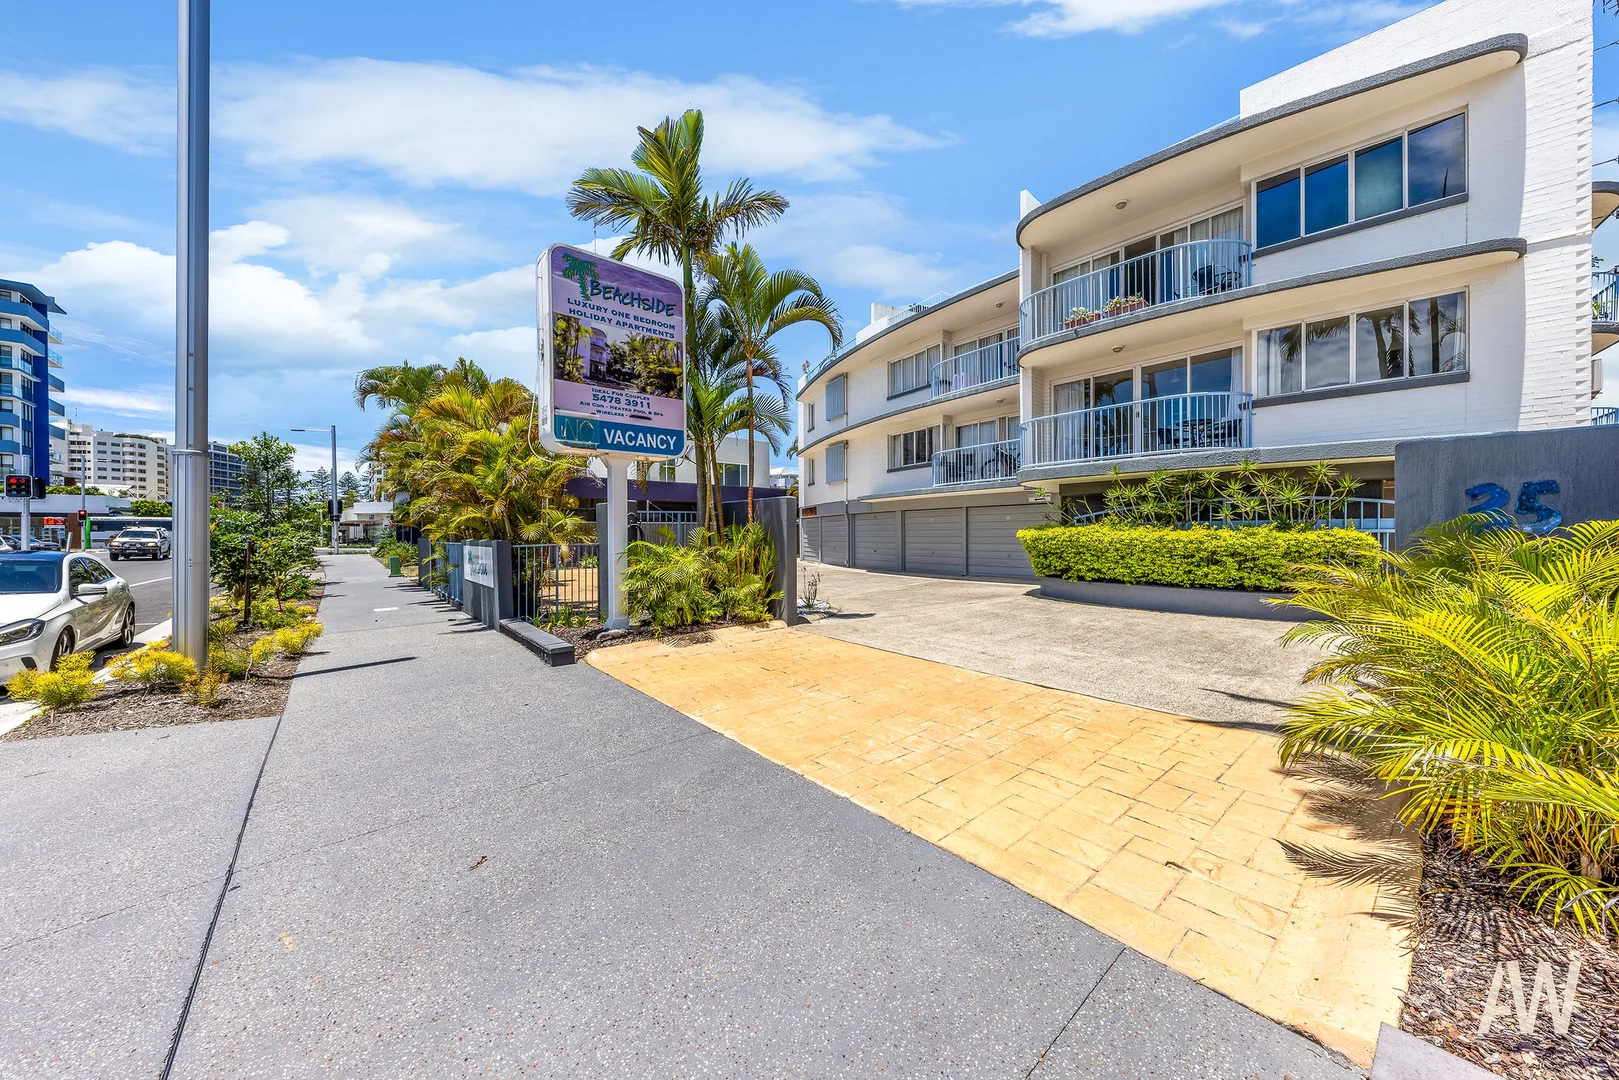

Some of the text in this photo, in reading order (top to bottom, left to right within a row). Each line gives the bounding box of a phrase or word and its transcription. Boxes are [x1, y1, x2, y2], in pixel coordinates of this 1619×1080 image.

[567, 297, 676, 331] LUXURY ONE BEDROOM
[590, 279, 676, 317] BEACHSIDE
[568, 308, 675, 339] HOLIDAY APARTMENTS
[592, 394, 651, 409] 5478 3911
[603, 428, 677, 450] VACANCY
[1465, 480, 1562, 534] 25
